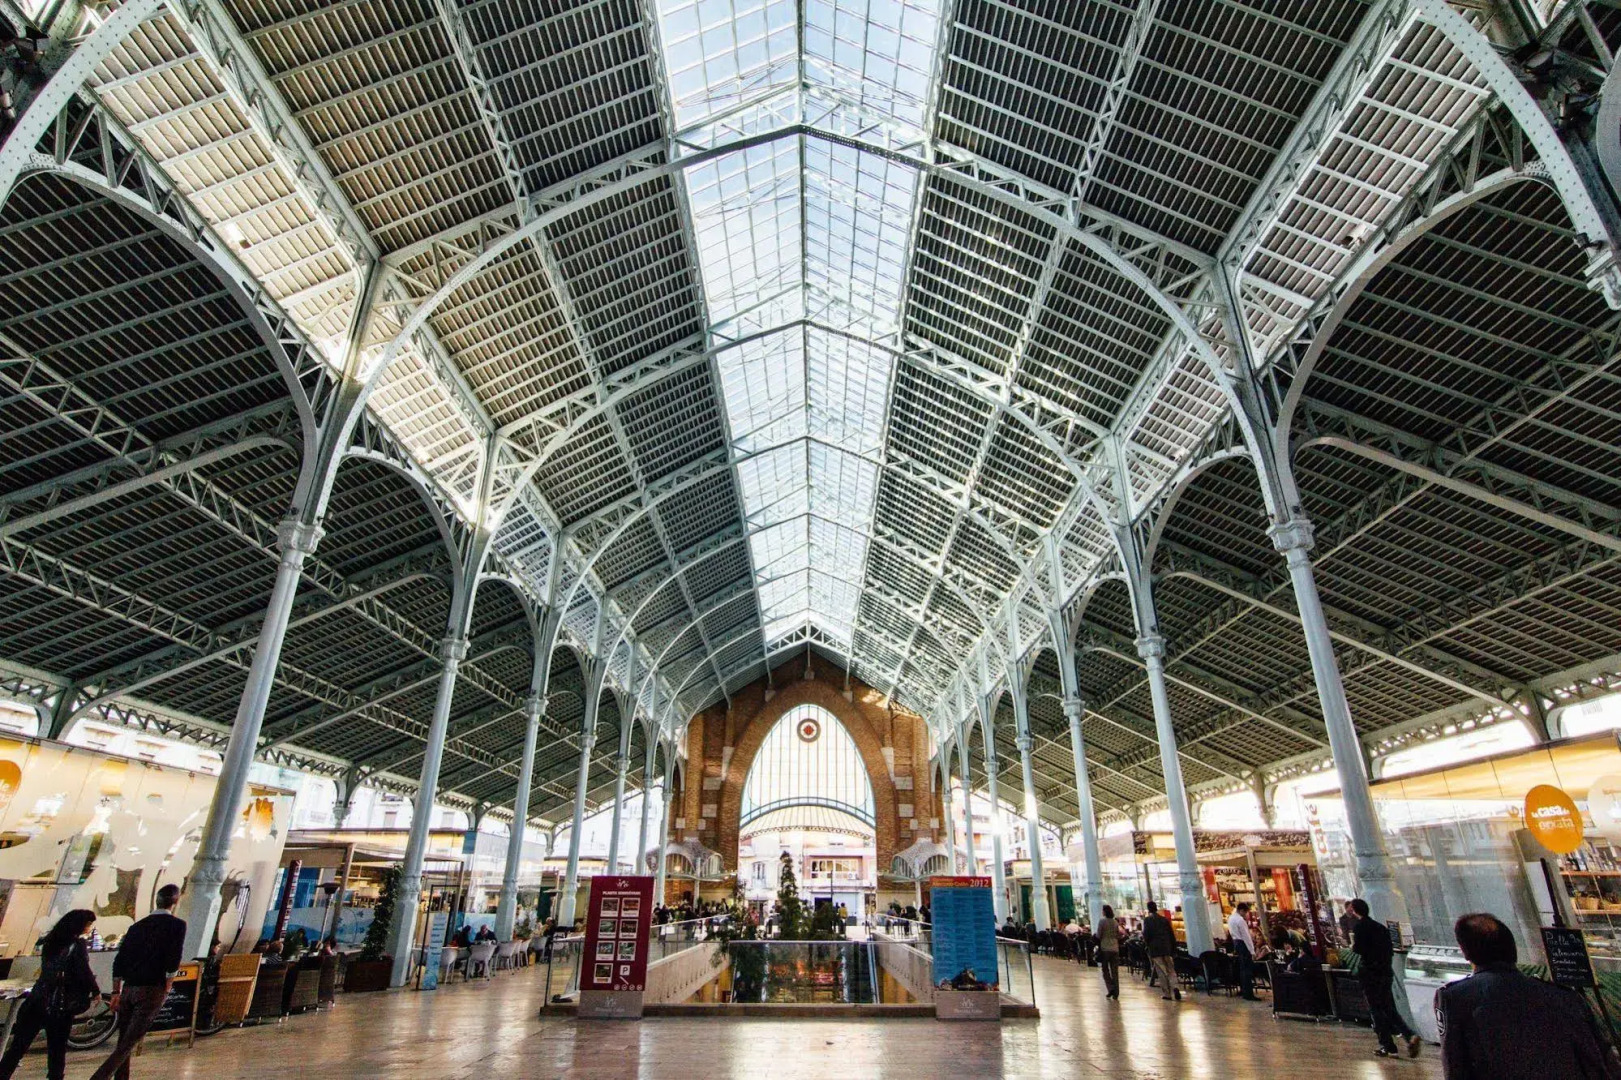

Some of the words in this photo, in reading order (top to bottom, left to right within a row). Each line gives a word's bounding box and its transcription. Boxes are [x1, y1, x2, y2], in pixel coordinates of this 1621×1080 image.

[1538, 805, 1562, 818] casa
[969, 879, 989, 887] 2012
[622, 966, 629, 975] P
